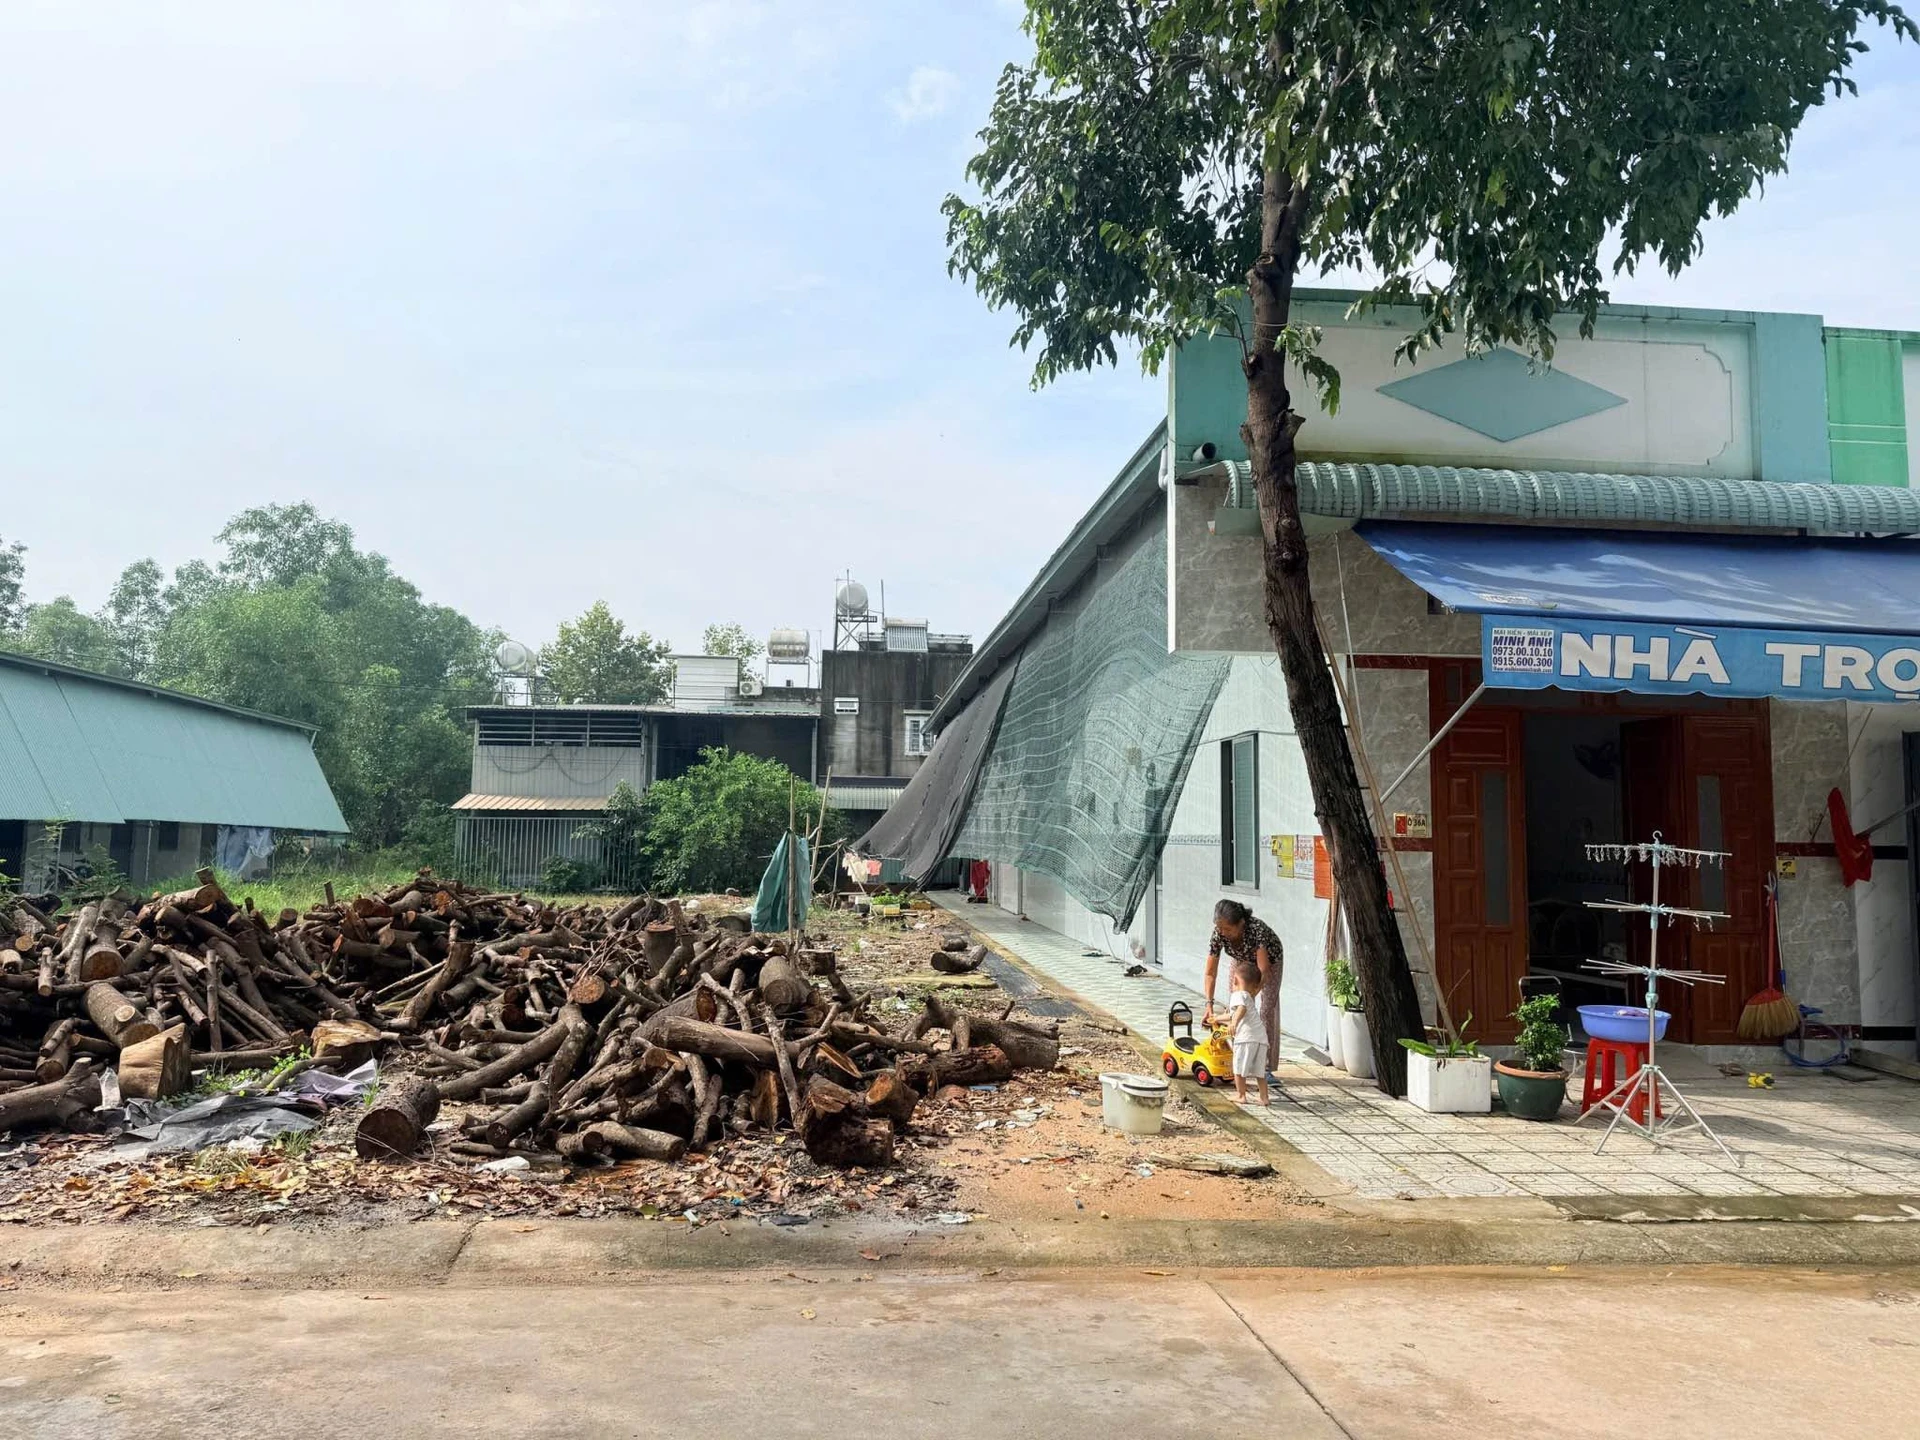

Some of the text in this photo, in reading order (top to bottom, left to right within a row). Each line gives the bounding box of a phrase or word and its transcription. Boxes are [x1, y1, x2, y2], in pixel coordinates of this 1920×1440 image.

[1493, 636, 1553, 647] MINH ANH
[1492, 646, 1553, 657] 0973.00.10.10
[1492, 656, 1553, 667] 0915.600.300
[1560, 627, 1920, 699] NHÀ TRỌ
